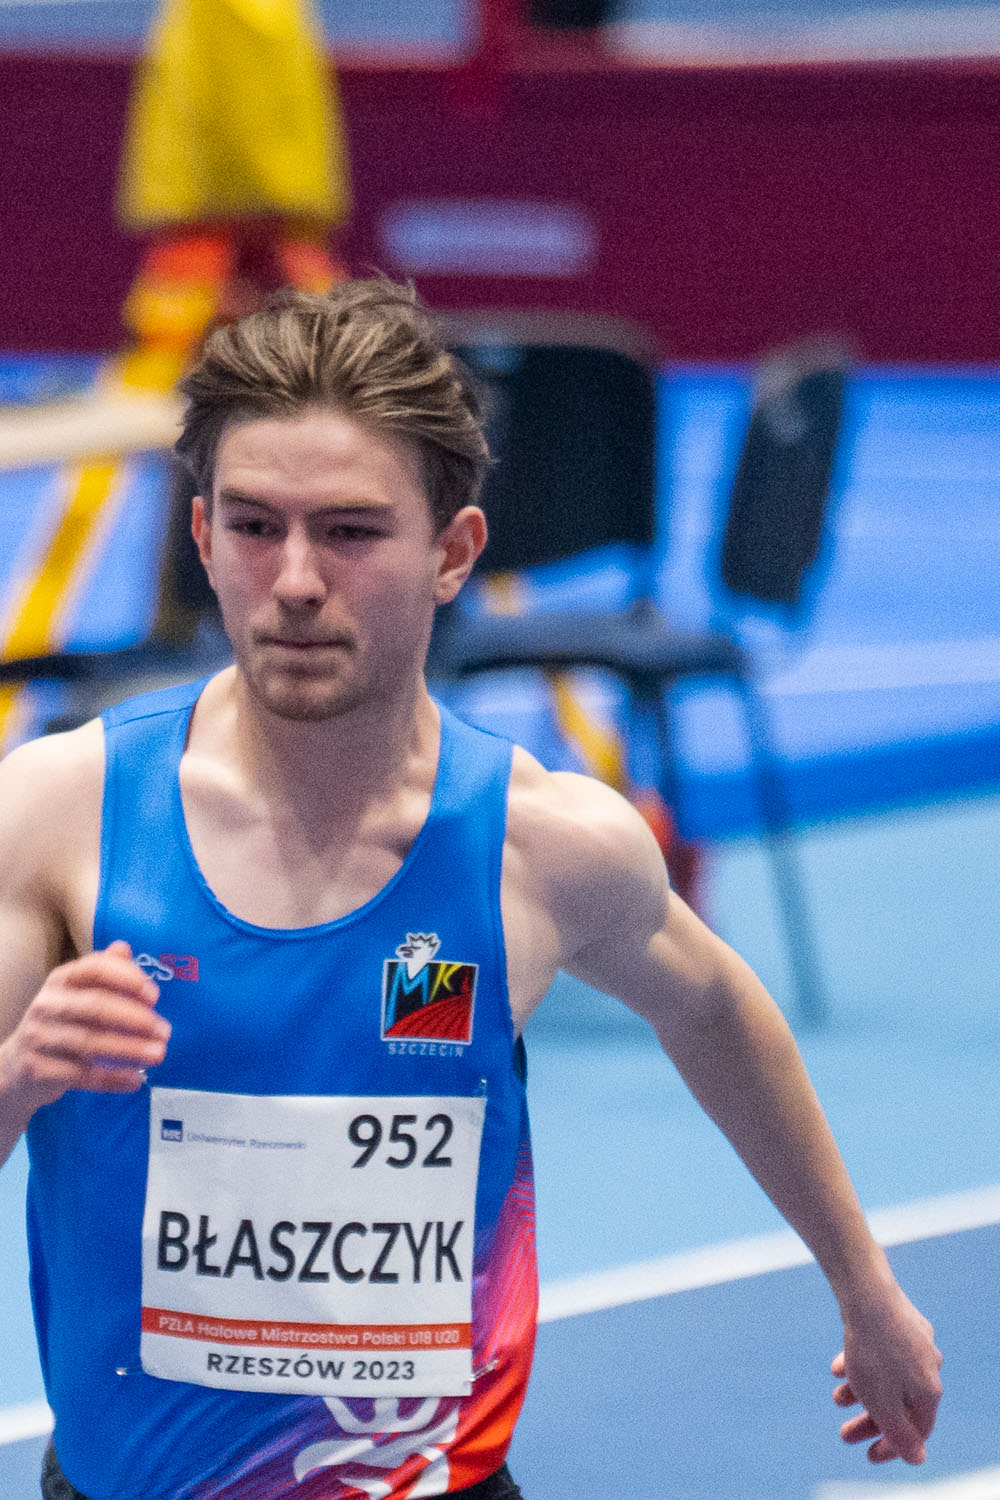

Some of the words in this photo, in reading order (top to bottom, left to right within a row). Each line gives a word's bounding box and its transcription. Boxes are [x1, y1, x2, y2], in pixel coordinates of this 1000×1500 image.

[348, 1113, 453, 1169] 952
[157, 1211, 464, 1284] BŁASZCZYK
[159, 1316, 194, 1333] PZLA
[199, 1322, 257, 1340] Halowe
[261, 1327, 359, 1345] Mistrzostwa
[362, 1332, 405, 1345] Polski
[409, 1331, 432, 1345] U18
[435, 1329, 459, 1343] U20
[207, 1353, 345, 1379] RZESZÓW
[353, 1360, 415, 1380] 2023
